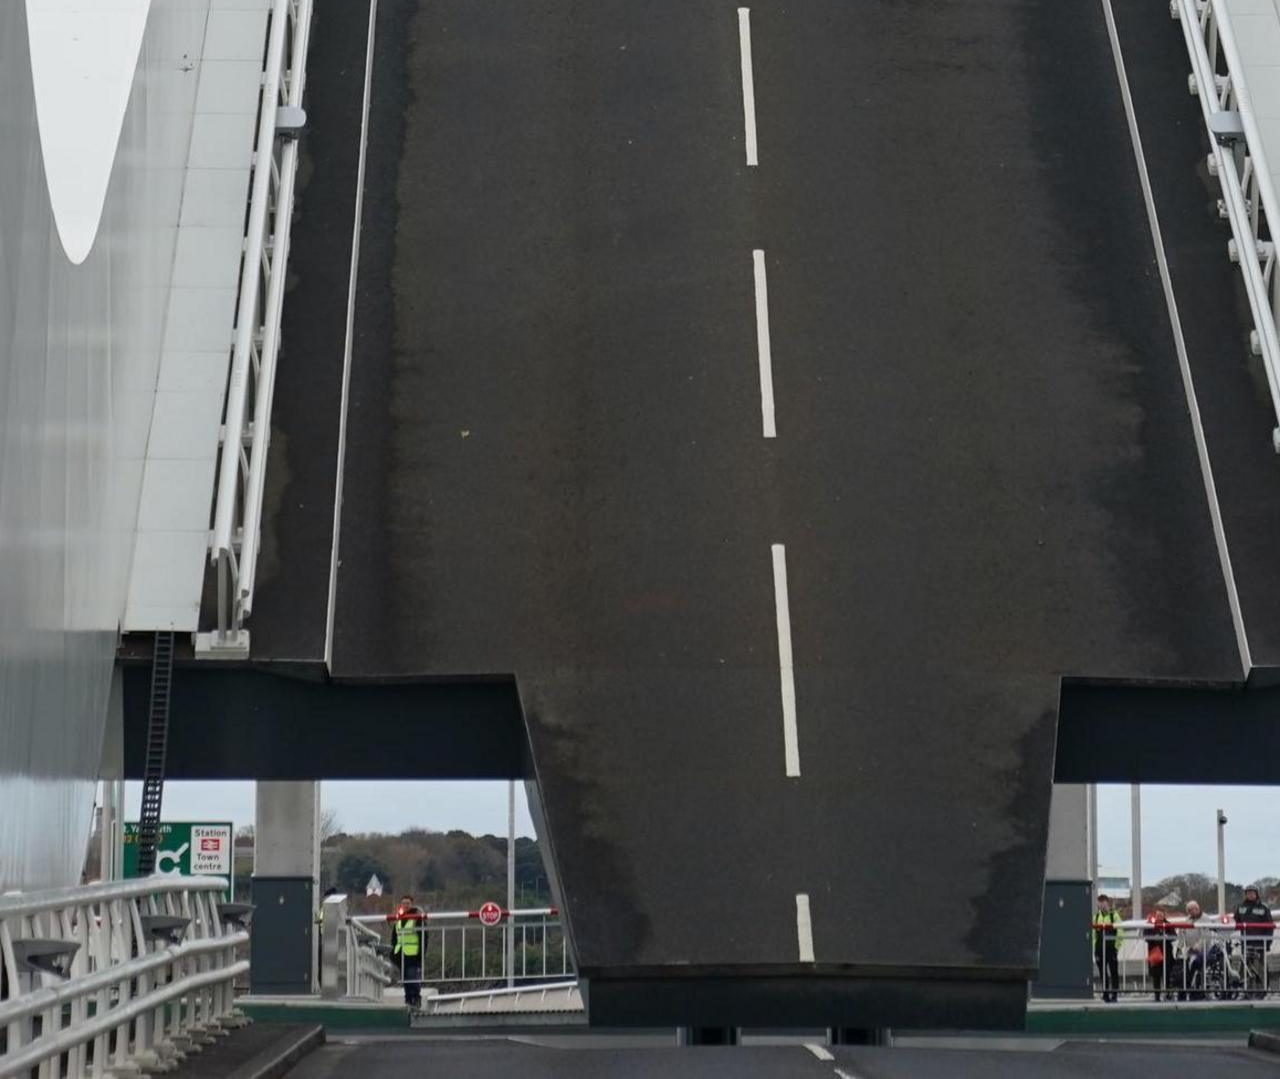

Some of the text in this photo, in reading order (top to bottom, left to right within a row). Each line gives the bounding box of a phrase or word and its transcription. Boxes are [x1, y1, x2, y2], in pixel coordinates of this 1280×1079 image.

[194, 828, 227, 838] Station
[197, 853, 219, 861] Town
[194, 862, 222, 870] centre
[482, 911, 498, 920] STOP
